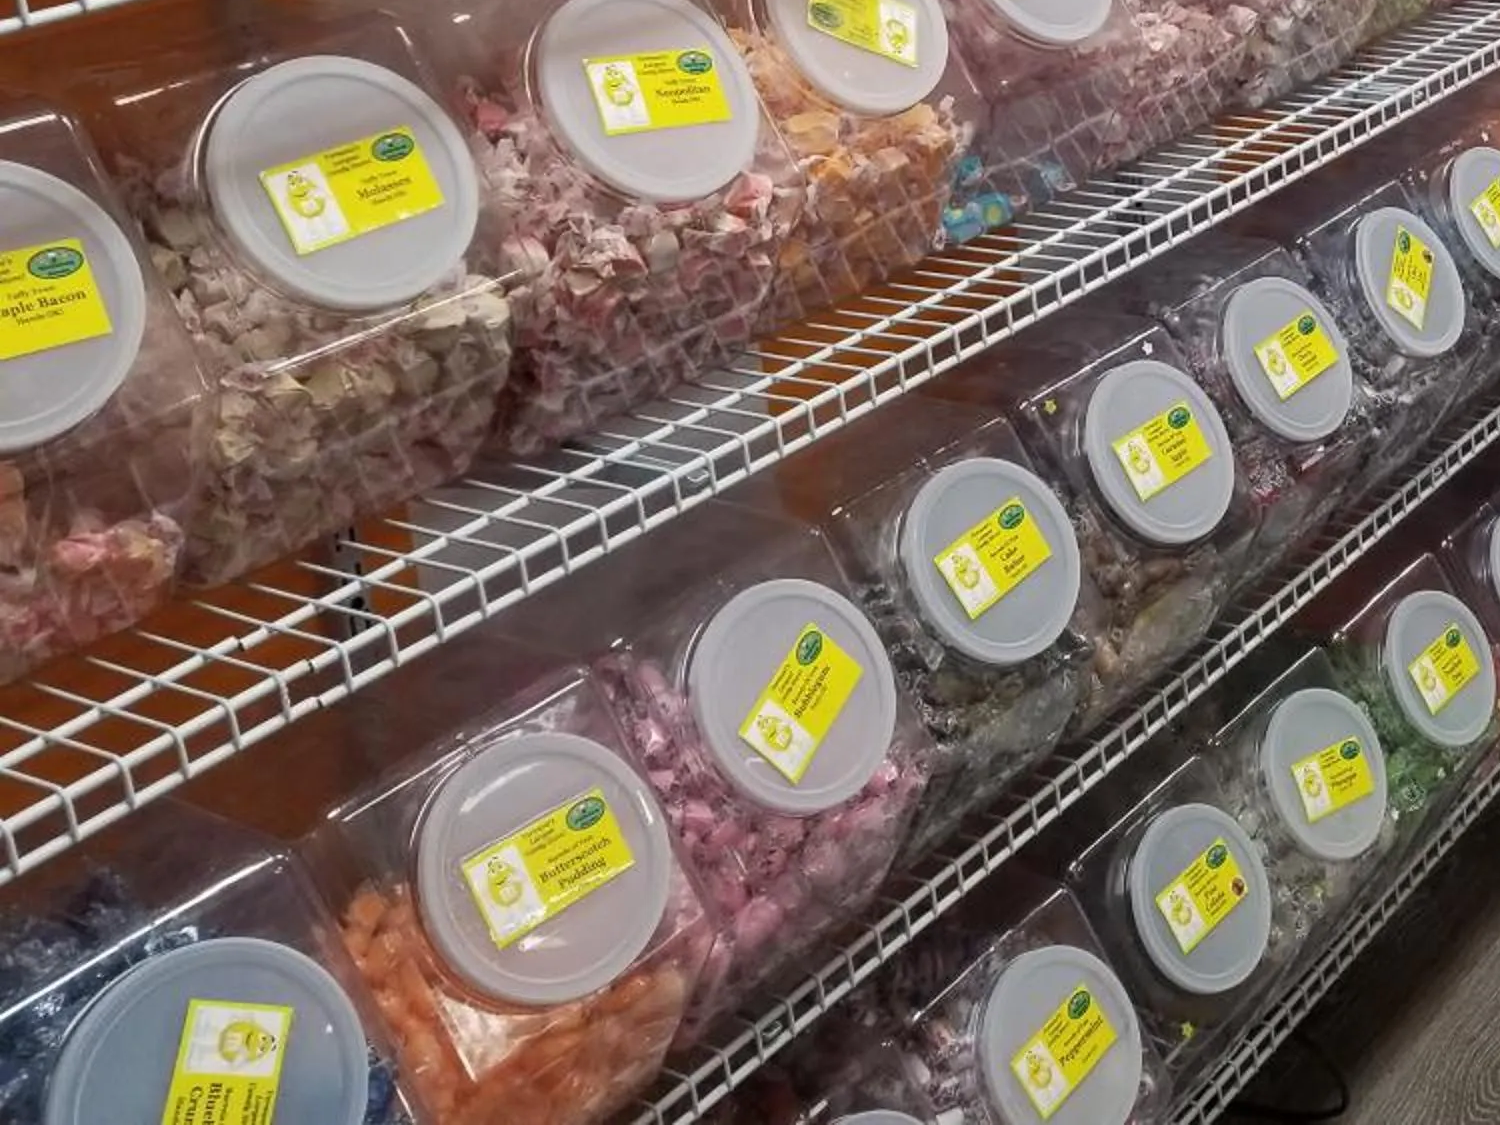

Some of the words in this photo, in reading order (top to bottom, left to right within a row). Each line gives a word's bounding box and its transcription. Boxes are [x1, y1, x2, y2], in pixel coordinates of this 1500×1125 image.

[37, 290, 87, 308] Bacon
[539, 837, 611, 884] Butterscotch
[559, 856, 607, 889] Pudding
[1059, 1015, 1104, 1067] Peppermint
